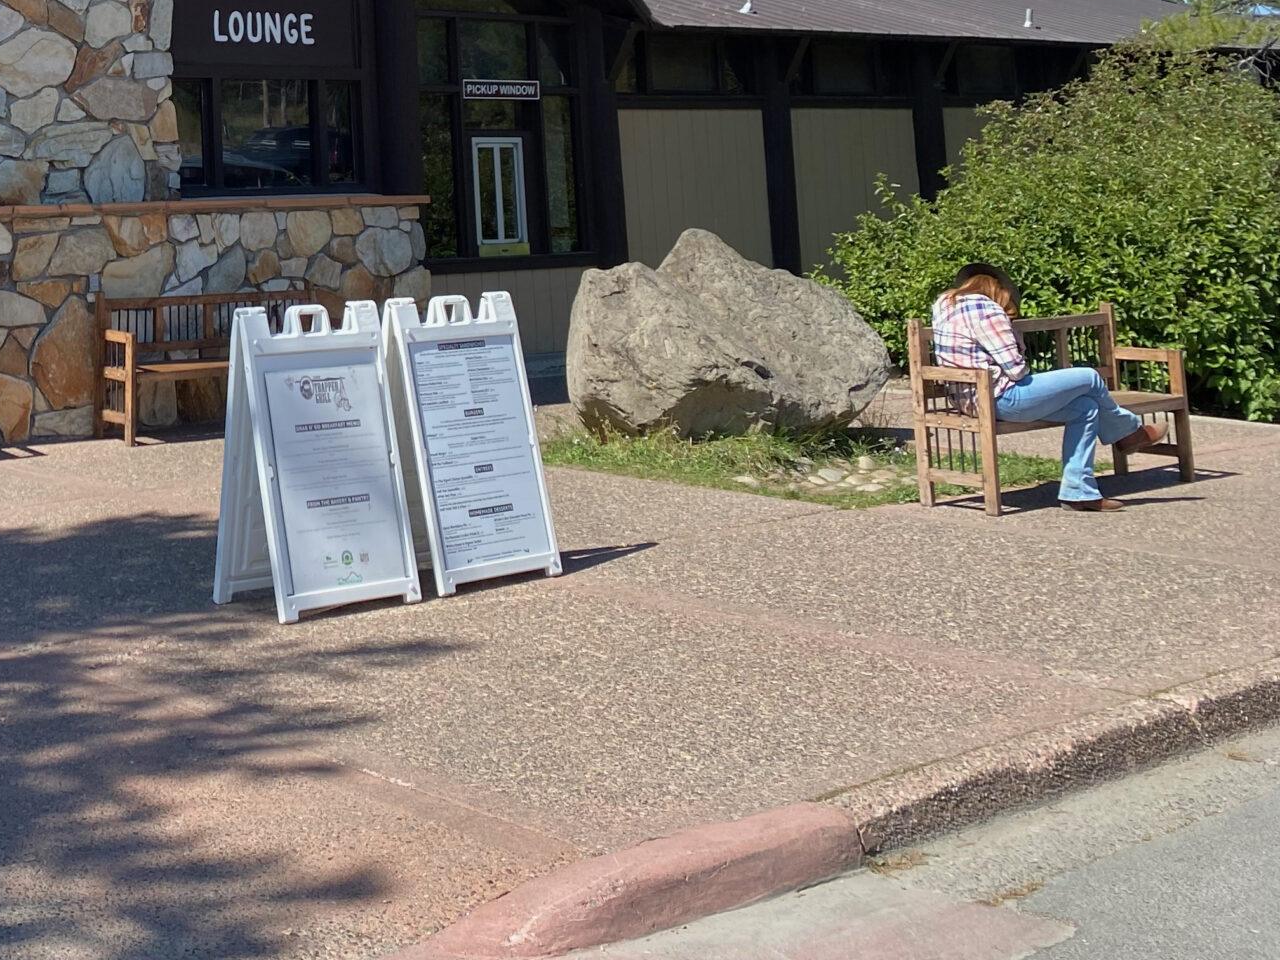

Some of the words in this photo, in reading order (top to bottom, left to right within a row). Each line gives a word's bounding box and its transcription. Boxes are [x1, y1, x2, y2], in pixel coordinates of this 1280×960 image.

[214, 10, 315, 45] LOUNGE
[466, 84, 498, 94] PICKUP
[500, 85, 535, 95] WINDOW
